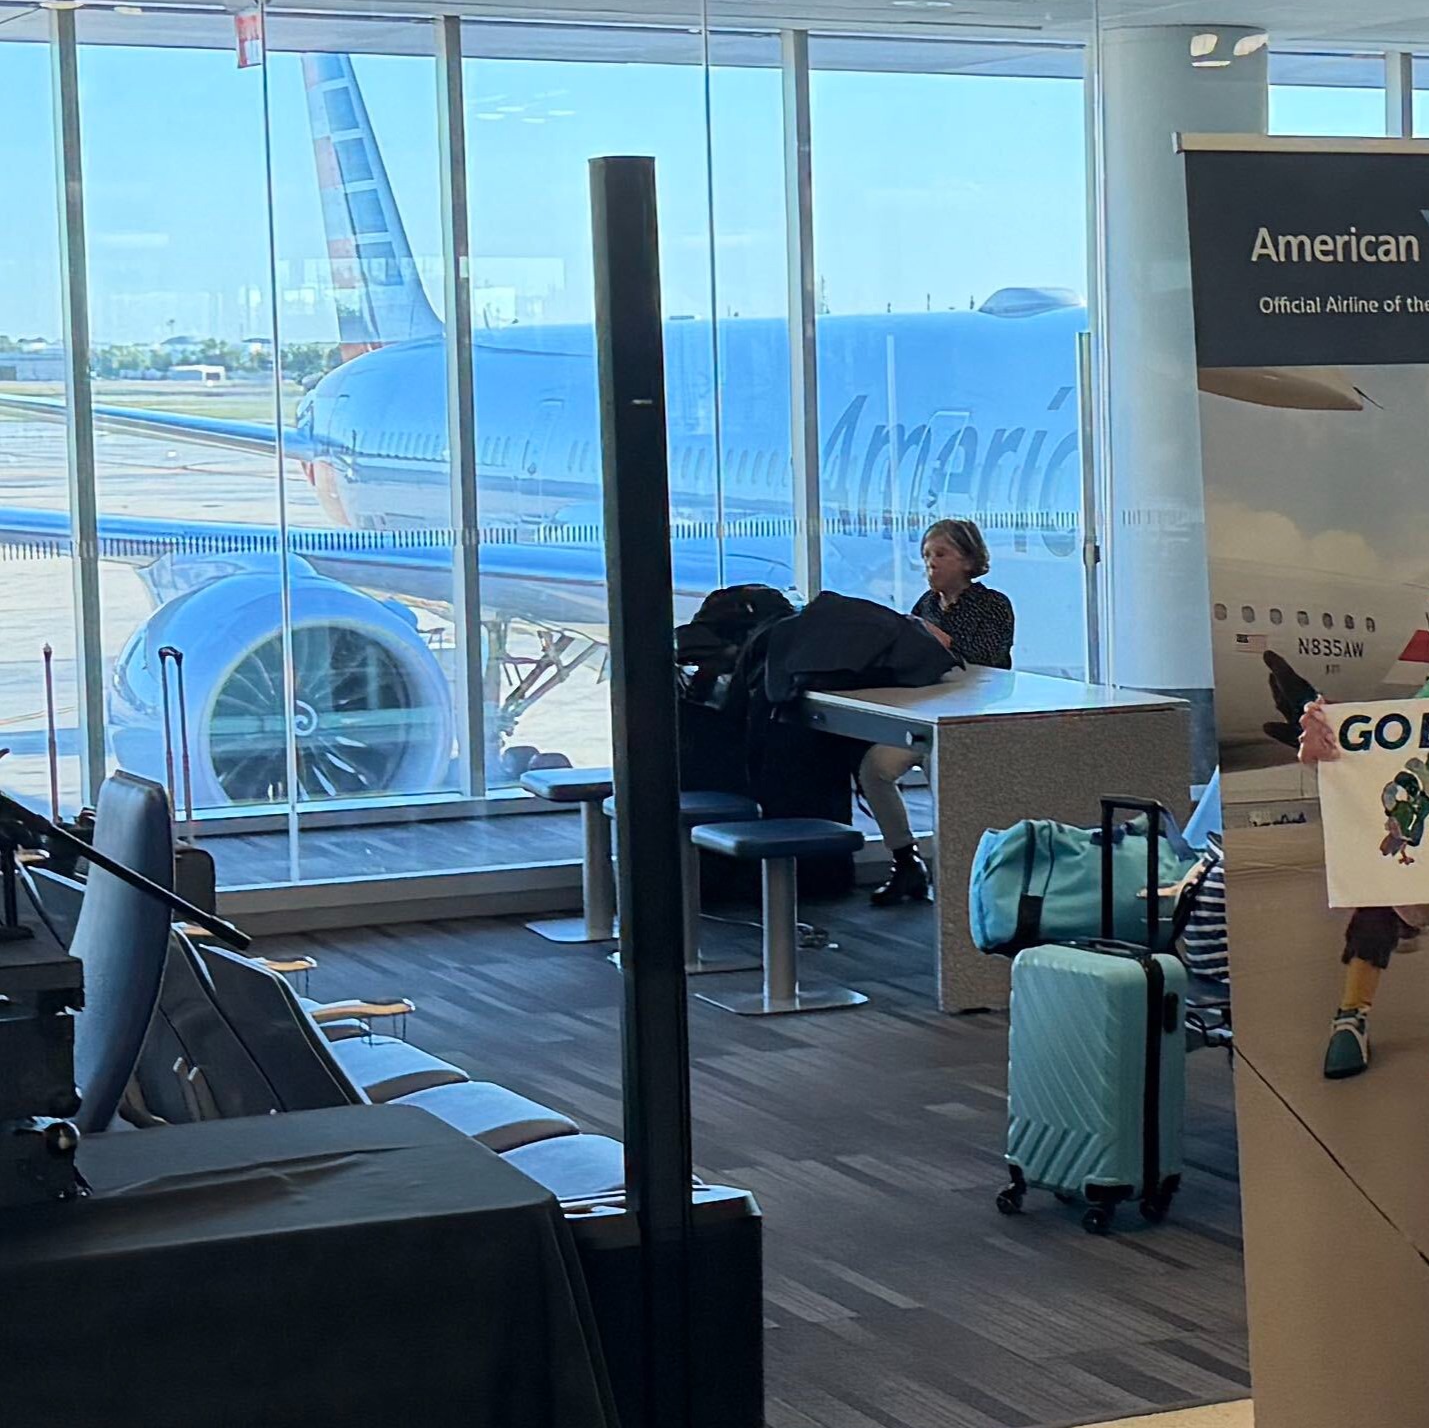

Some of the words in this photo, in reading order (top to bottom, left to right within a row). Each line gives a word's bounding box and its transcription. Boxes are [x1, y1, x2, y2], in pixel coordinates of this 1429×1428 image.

[1250, 227, 1420, 263] American
[1259, 296, 1321, 314] Official
[1326, 295, 1379, 313] Airline
[1384, 295, 1402, 313] of
[1339, 713, 1412, 752] GO
